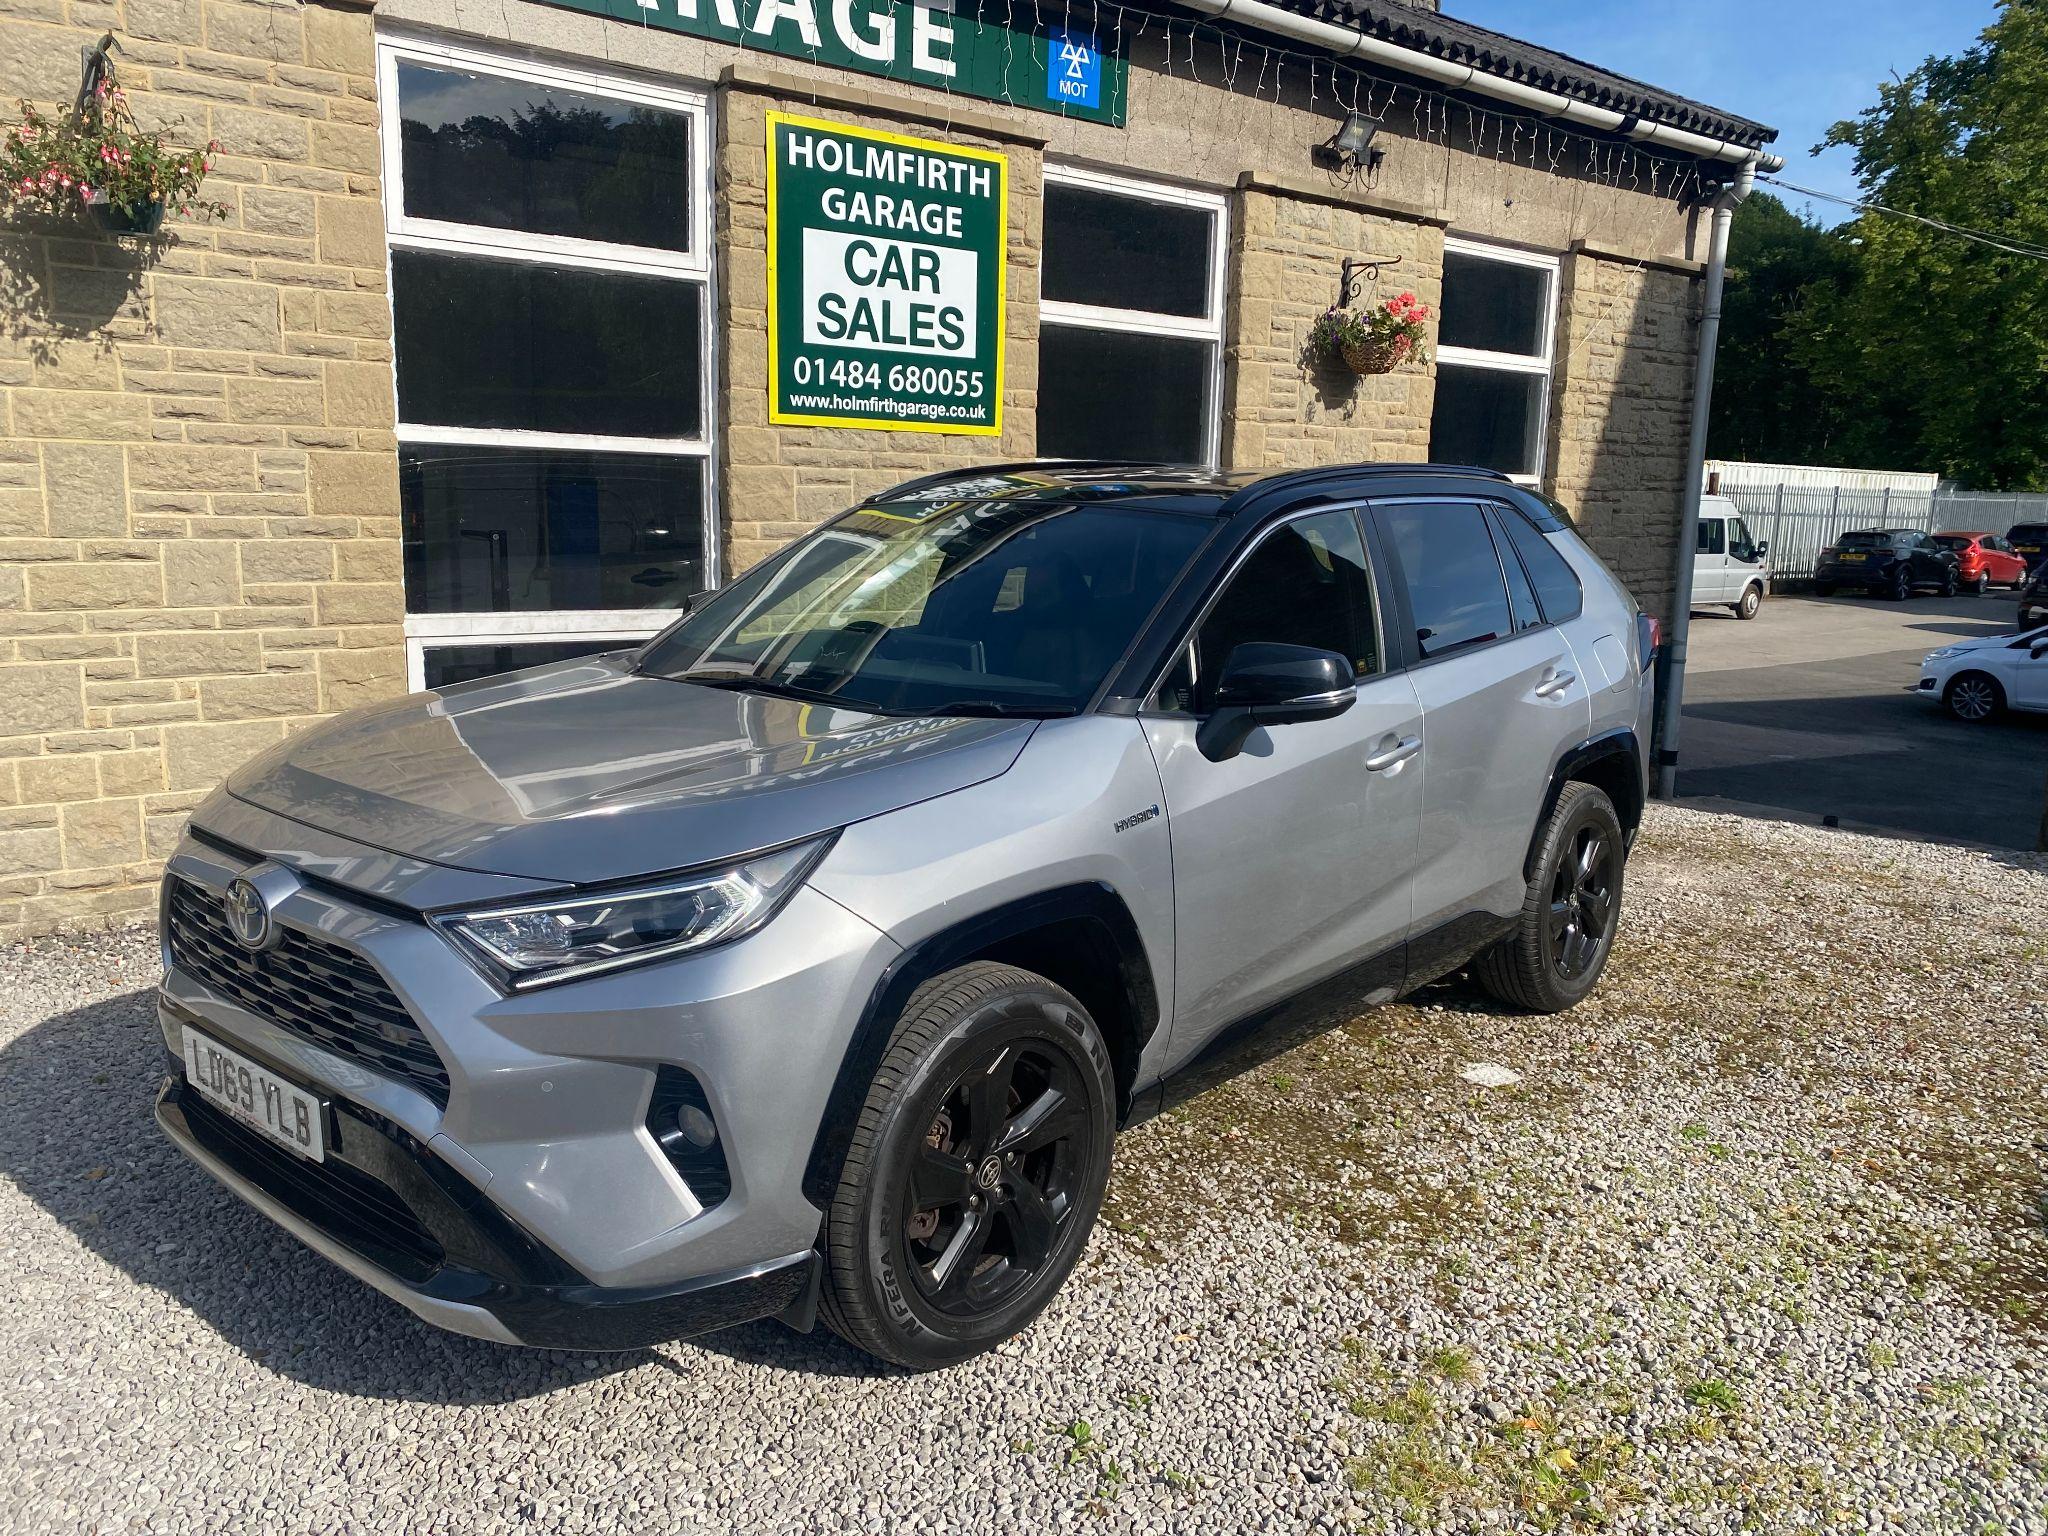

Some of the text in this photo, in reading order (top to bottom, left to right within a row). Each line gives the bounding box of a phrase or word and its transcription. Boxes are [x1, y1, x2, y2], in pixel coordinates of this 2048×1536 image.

[1060, 80, 1088, 98] MOT
[788, 132, 991, 198] HOLMFIRTH
[821, 187, 963, 239] GARAGE
[844, 239, 941, 295] CAR
[816, 292, 965, 351] SALES
[793, 356, 984, 398] 01484 680055
[790, 393, 986, 420] www.holmfirthgarage.co.uk
[1114, 808, 1155, 833] HYBRID
[192, 1039, 254, 1113] LD69
[259, 1077, 311, 1147] YLB
